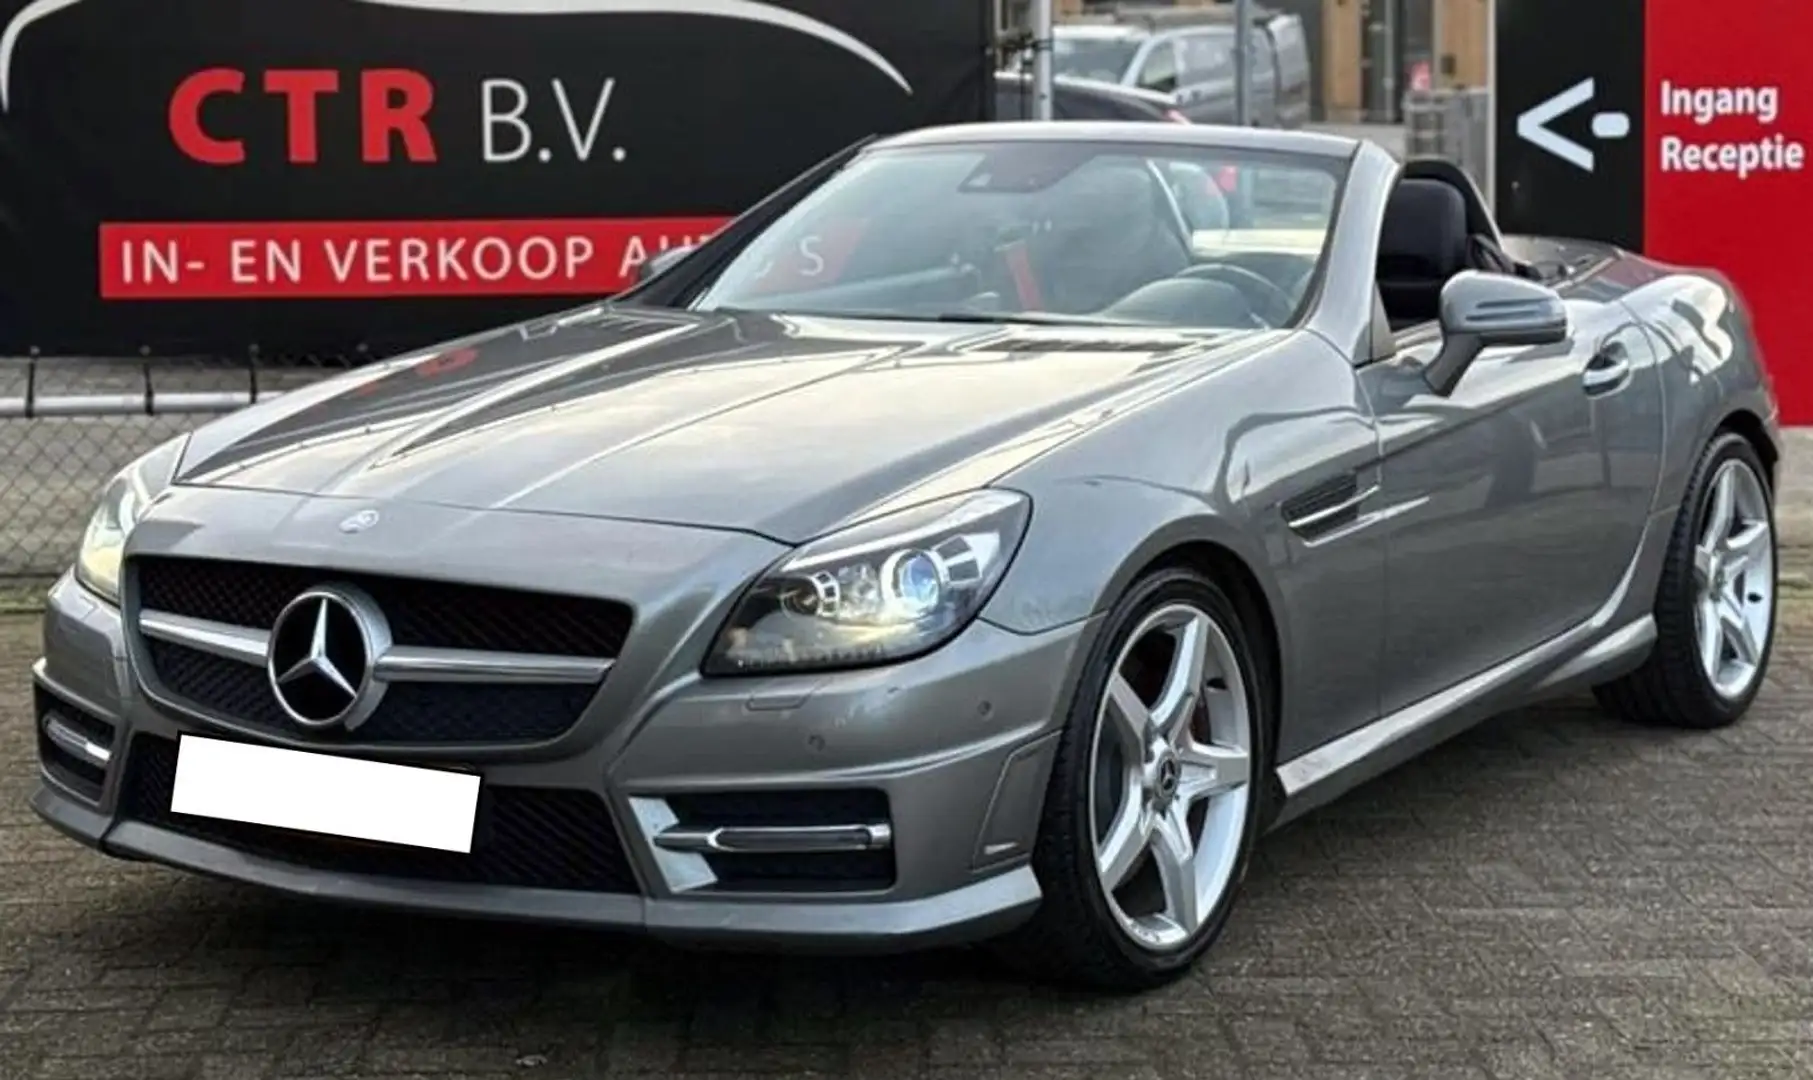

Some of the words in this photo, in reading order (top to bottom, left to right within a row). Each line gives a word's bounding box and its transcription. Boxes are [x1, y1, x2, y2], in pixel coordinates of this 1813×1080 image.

[168, 68, 437, 164] CTR
[481, 78, 626, 162] B.V.
[1661, 80, 1778, 125] Ingang
[1661, 133, 1804, 180] Receptie
[122, 239, 205, 284] IN-
[231, 239, 301, 284] EN
[323, 236, 594, 283] VERKOOP
